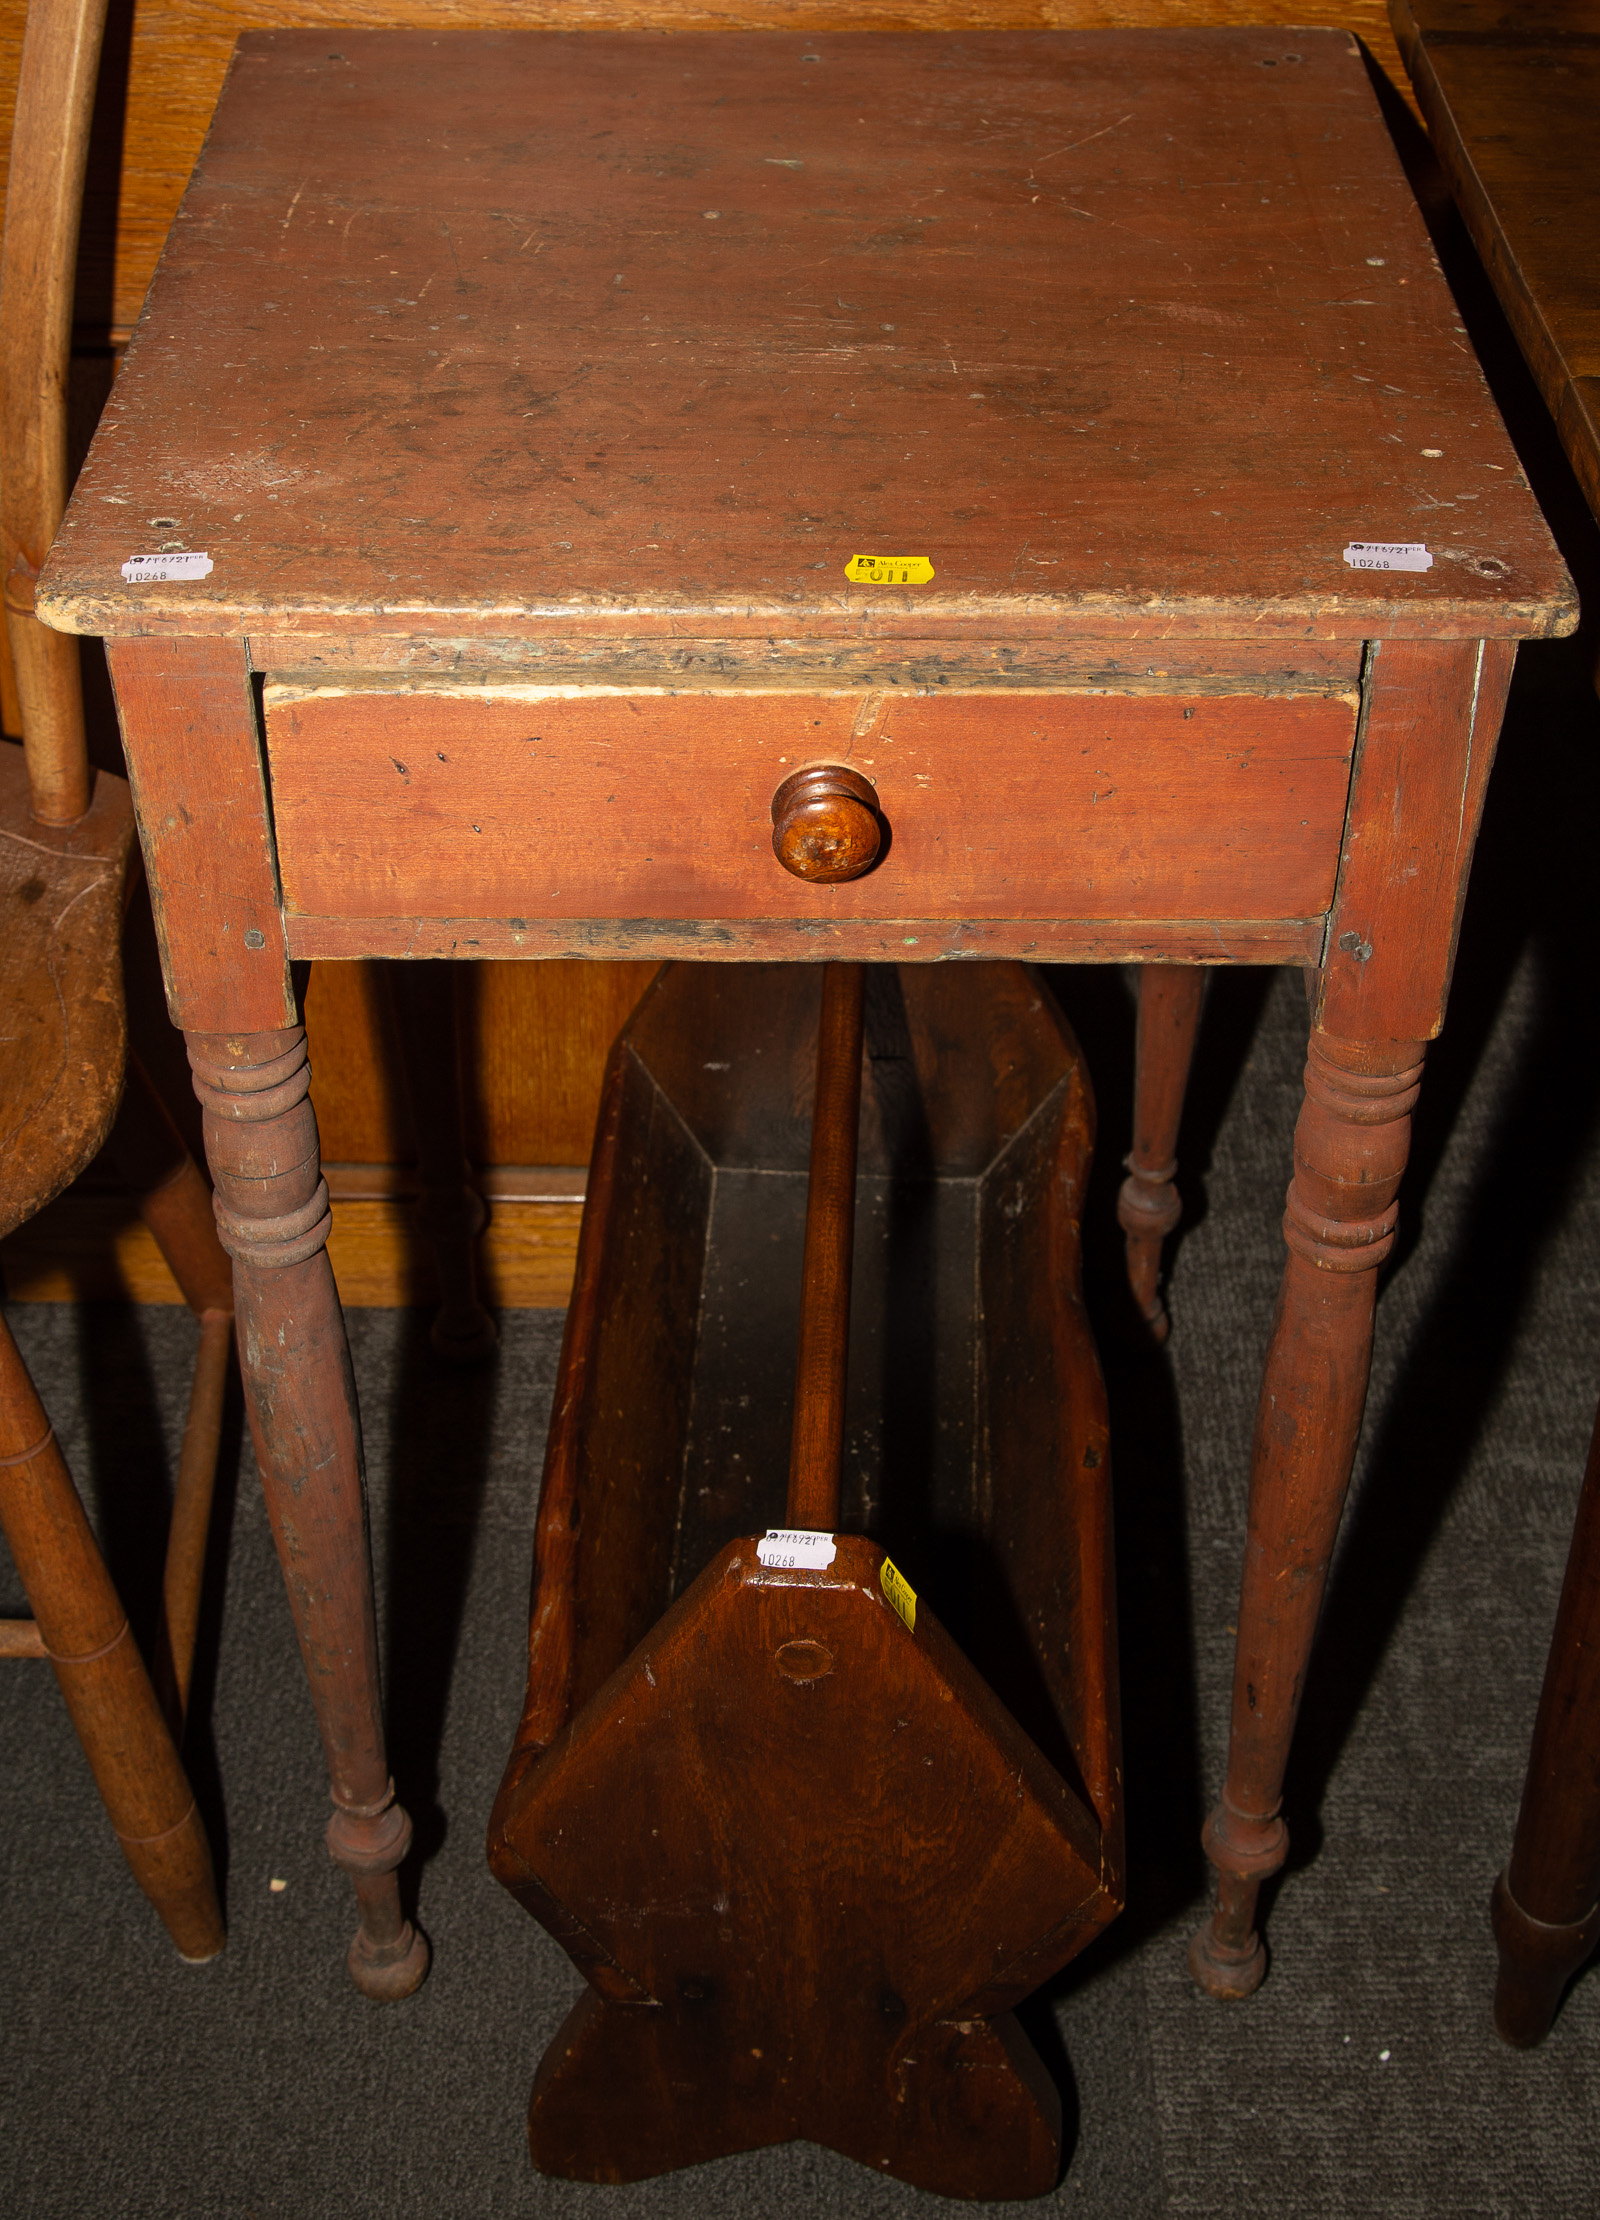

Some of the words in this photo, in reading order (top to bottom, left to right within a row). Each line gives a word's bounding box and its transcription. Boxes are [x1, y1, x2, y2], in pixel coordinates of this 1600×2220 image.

[895, 560, 921, 568] Cooper
[1352, 559, 1390, 569] 10268
[128, 571, 167, 582] 10268
[762, 1553, 795, 1567] 10268
